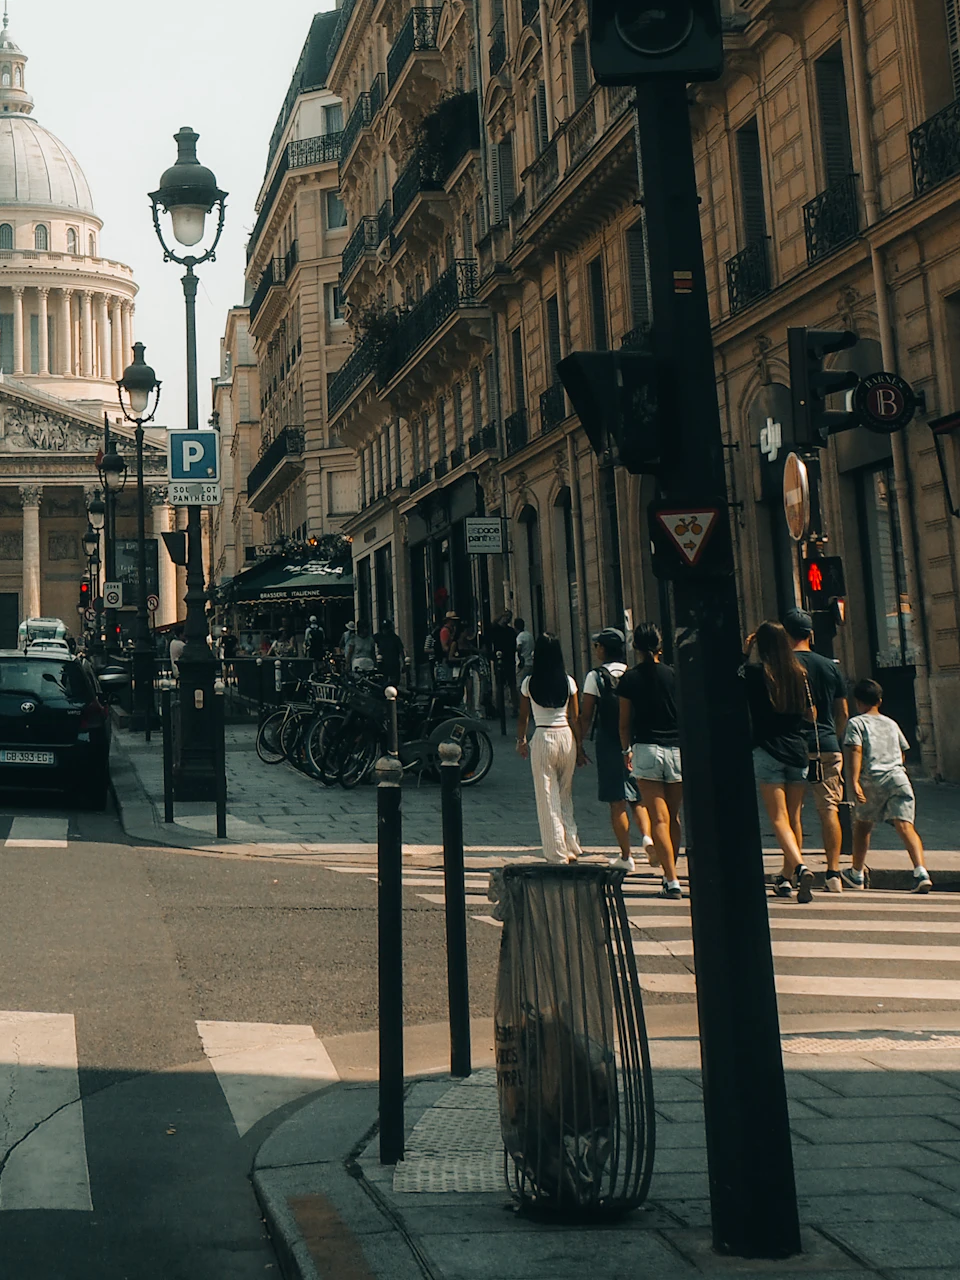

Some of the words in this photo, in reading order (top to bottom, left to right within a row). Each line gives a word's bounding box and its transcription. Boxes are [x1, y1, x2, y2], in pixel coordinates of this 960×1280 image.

[864, 375, 904, 389] BARNES
[875, 388, 898, 416] B
[760, 417, 782, 462] dji
[182, 440, 205, 472] P
[291, 589, 321, 597] ITALIENNE
